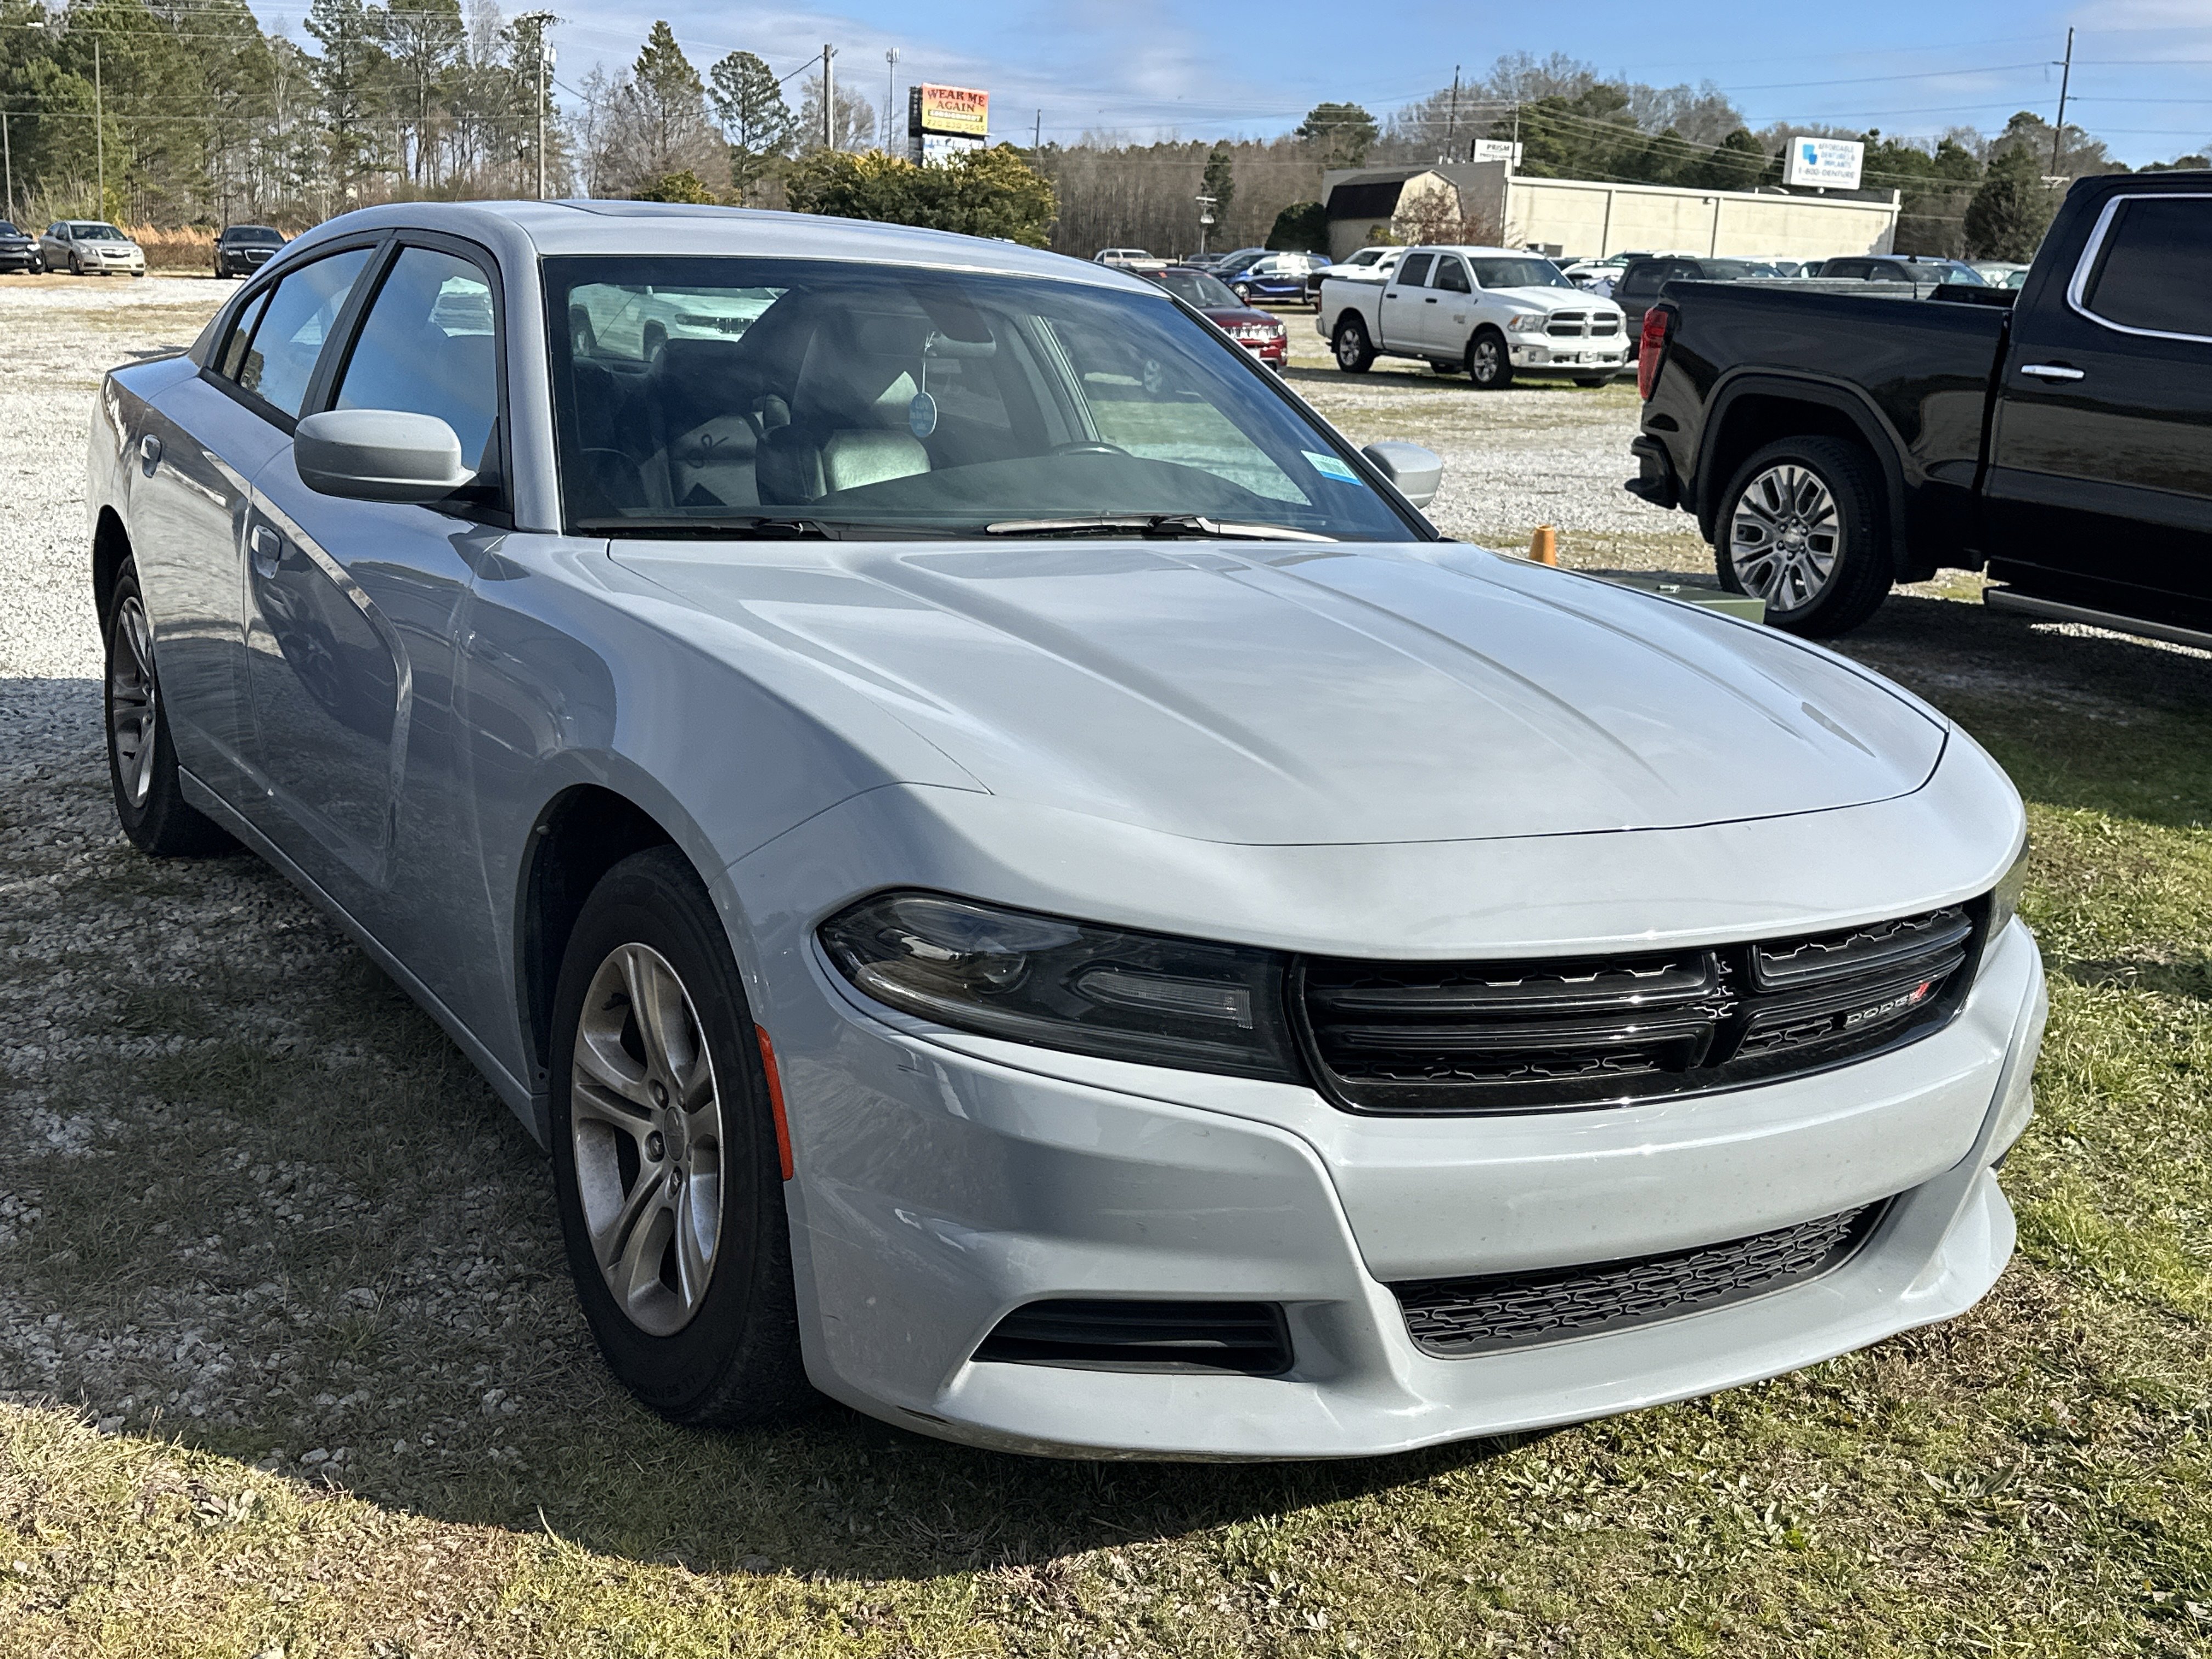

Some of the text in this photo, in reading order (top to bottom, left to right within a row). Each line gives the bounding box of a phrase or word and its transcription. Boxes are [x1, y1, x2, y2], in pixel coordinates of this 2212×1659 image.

[928, 89, 985, 106] WEAR ME
[936, 101, 974, 112] AGAIN
[1846, 994, 1922, 1025] DODGE
